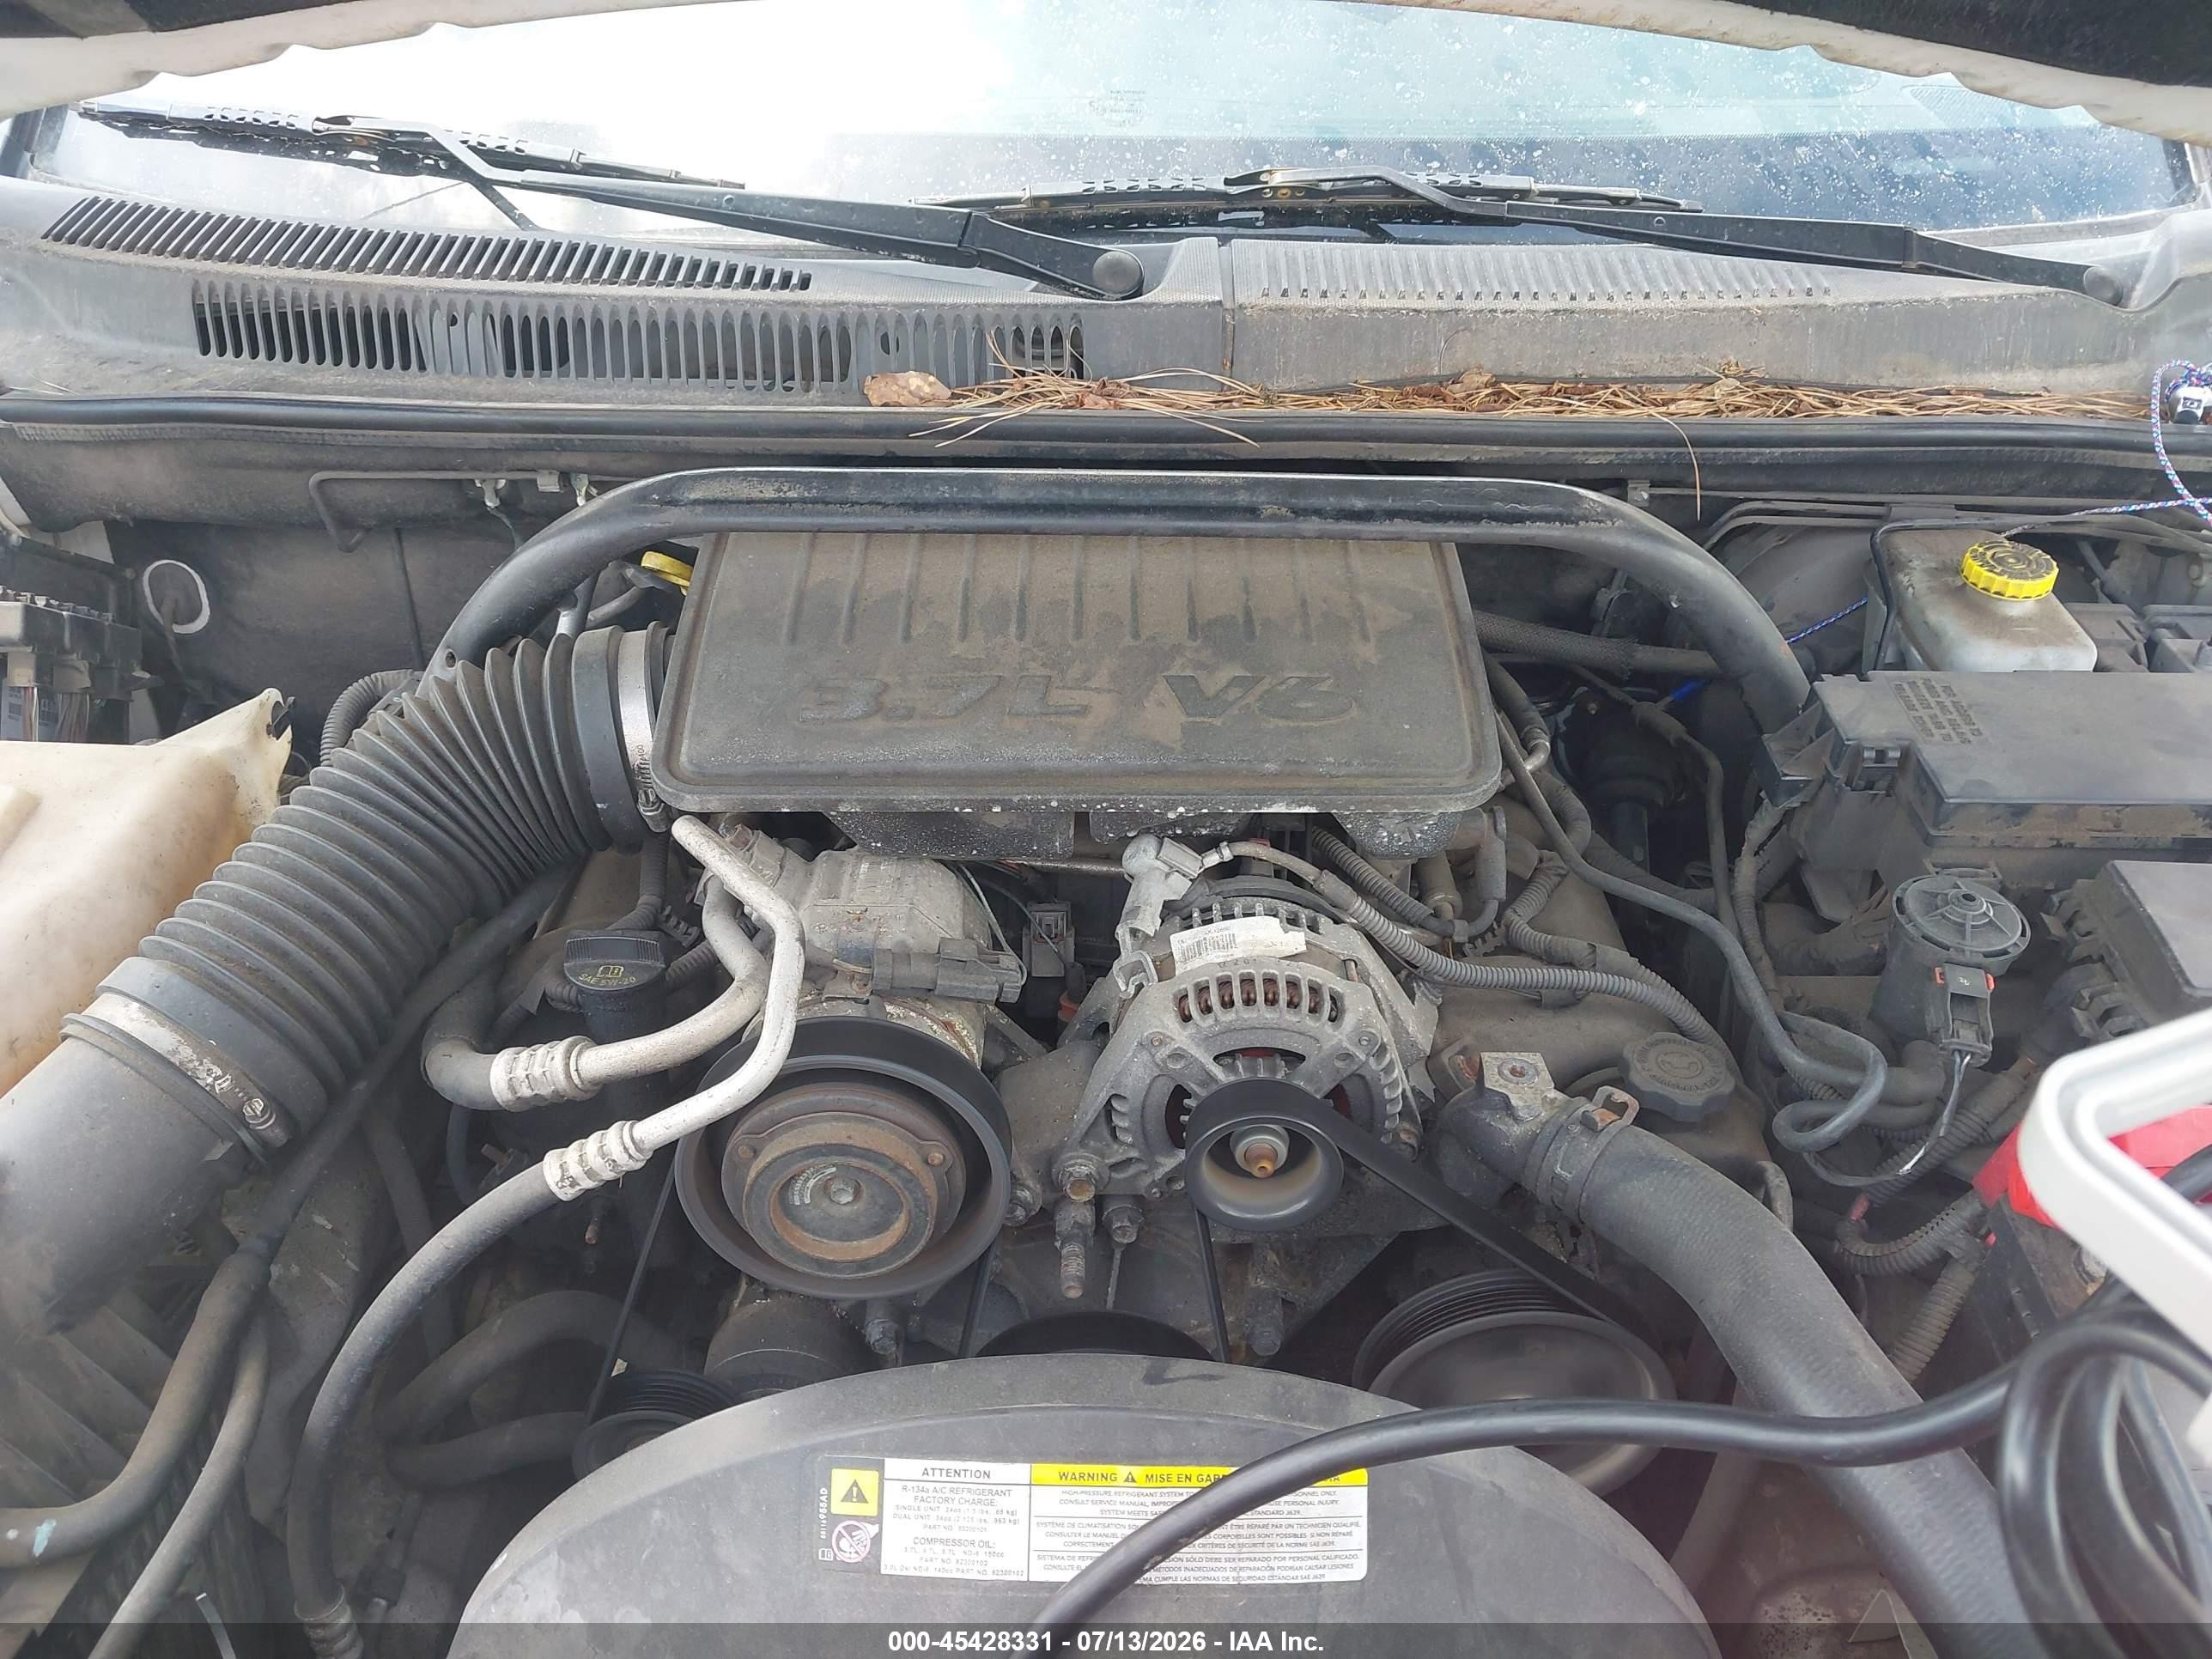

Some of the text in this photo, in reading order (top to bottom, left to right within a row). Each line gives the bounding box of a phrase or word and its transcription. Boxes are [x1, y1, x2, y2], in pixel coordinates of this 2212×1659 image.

[799, 673, 1357, 723] 3.7L V6
[578, 973, 599, 985] SAE
[921, 1467, 991, 1480] ATTENTION
[1058, 1471, 1118, 1482] WARNING
[1146, 1473, 1173, 1483] MISE
[1176, 1474, 1193, 1483] EN
[902, 1485, 929, 1494] R-134a
[949, 1486, 1013, 1497] REFRIGERANT
[914, 1495, 956, 1504] FACTORY
[913, 1537, 996, 1549] COMPRESSOR OIL:
